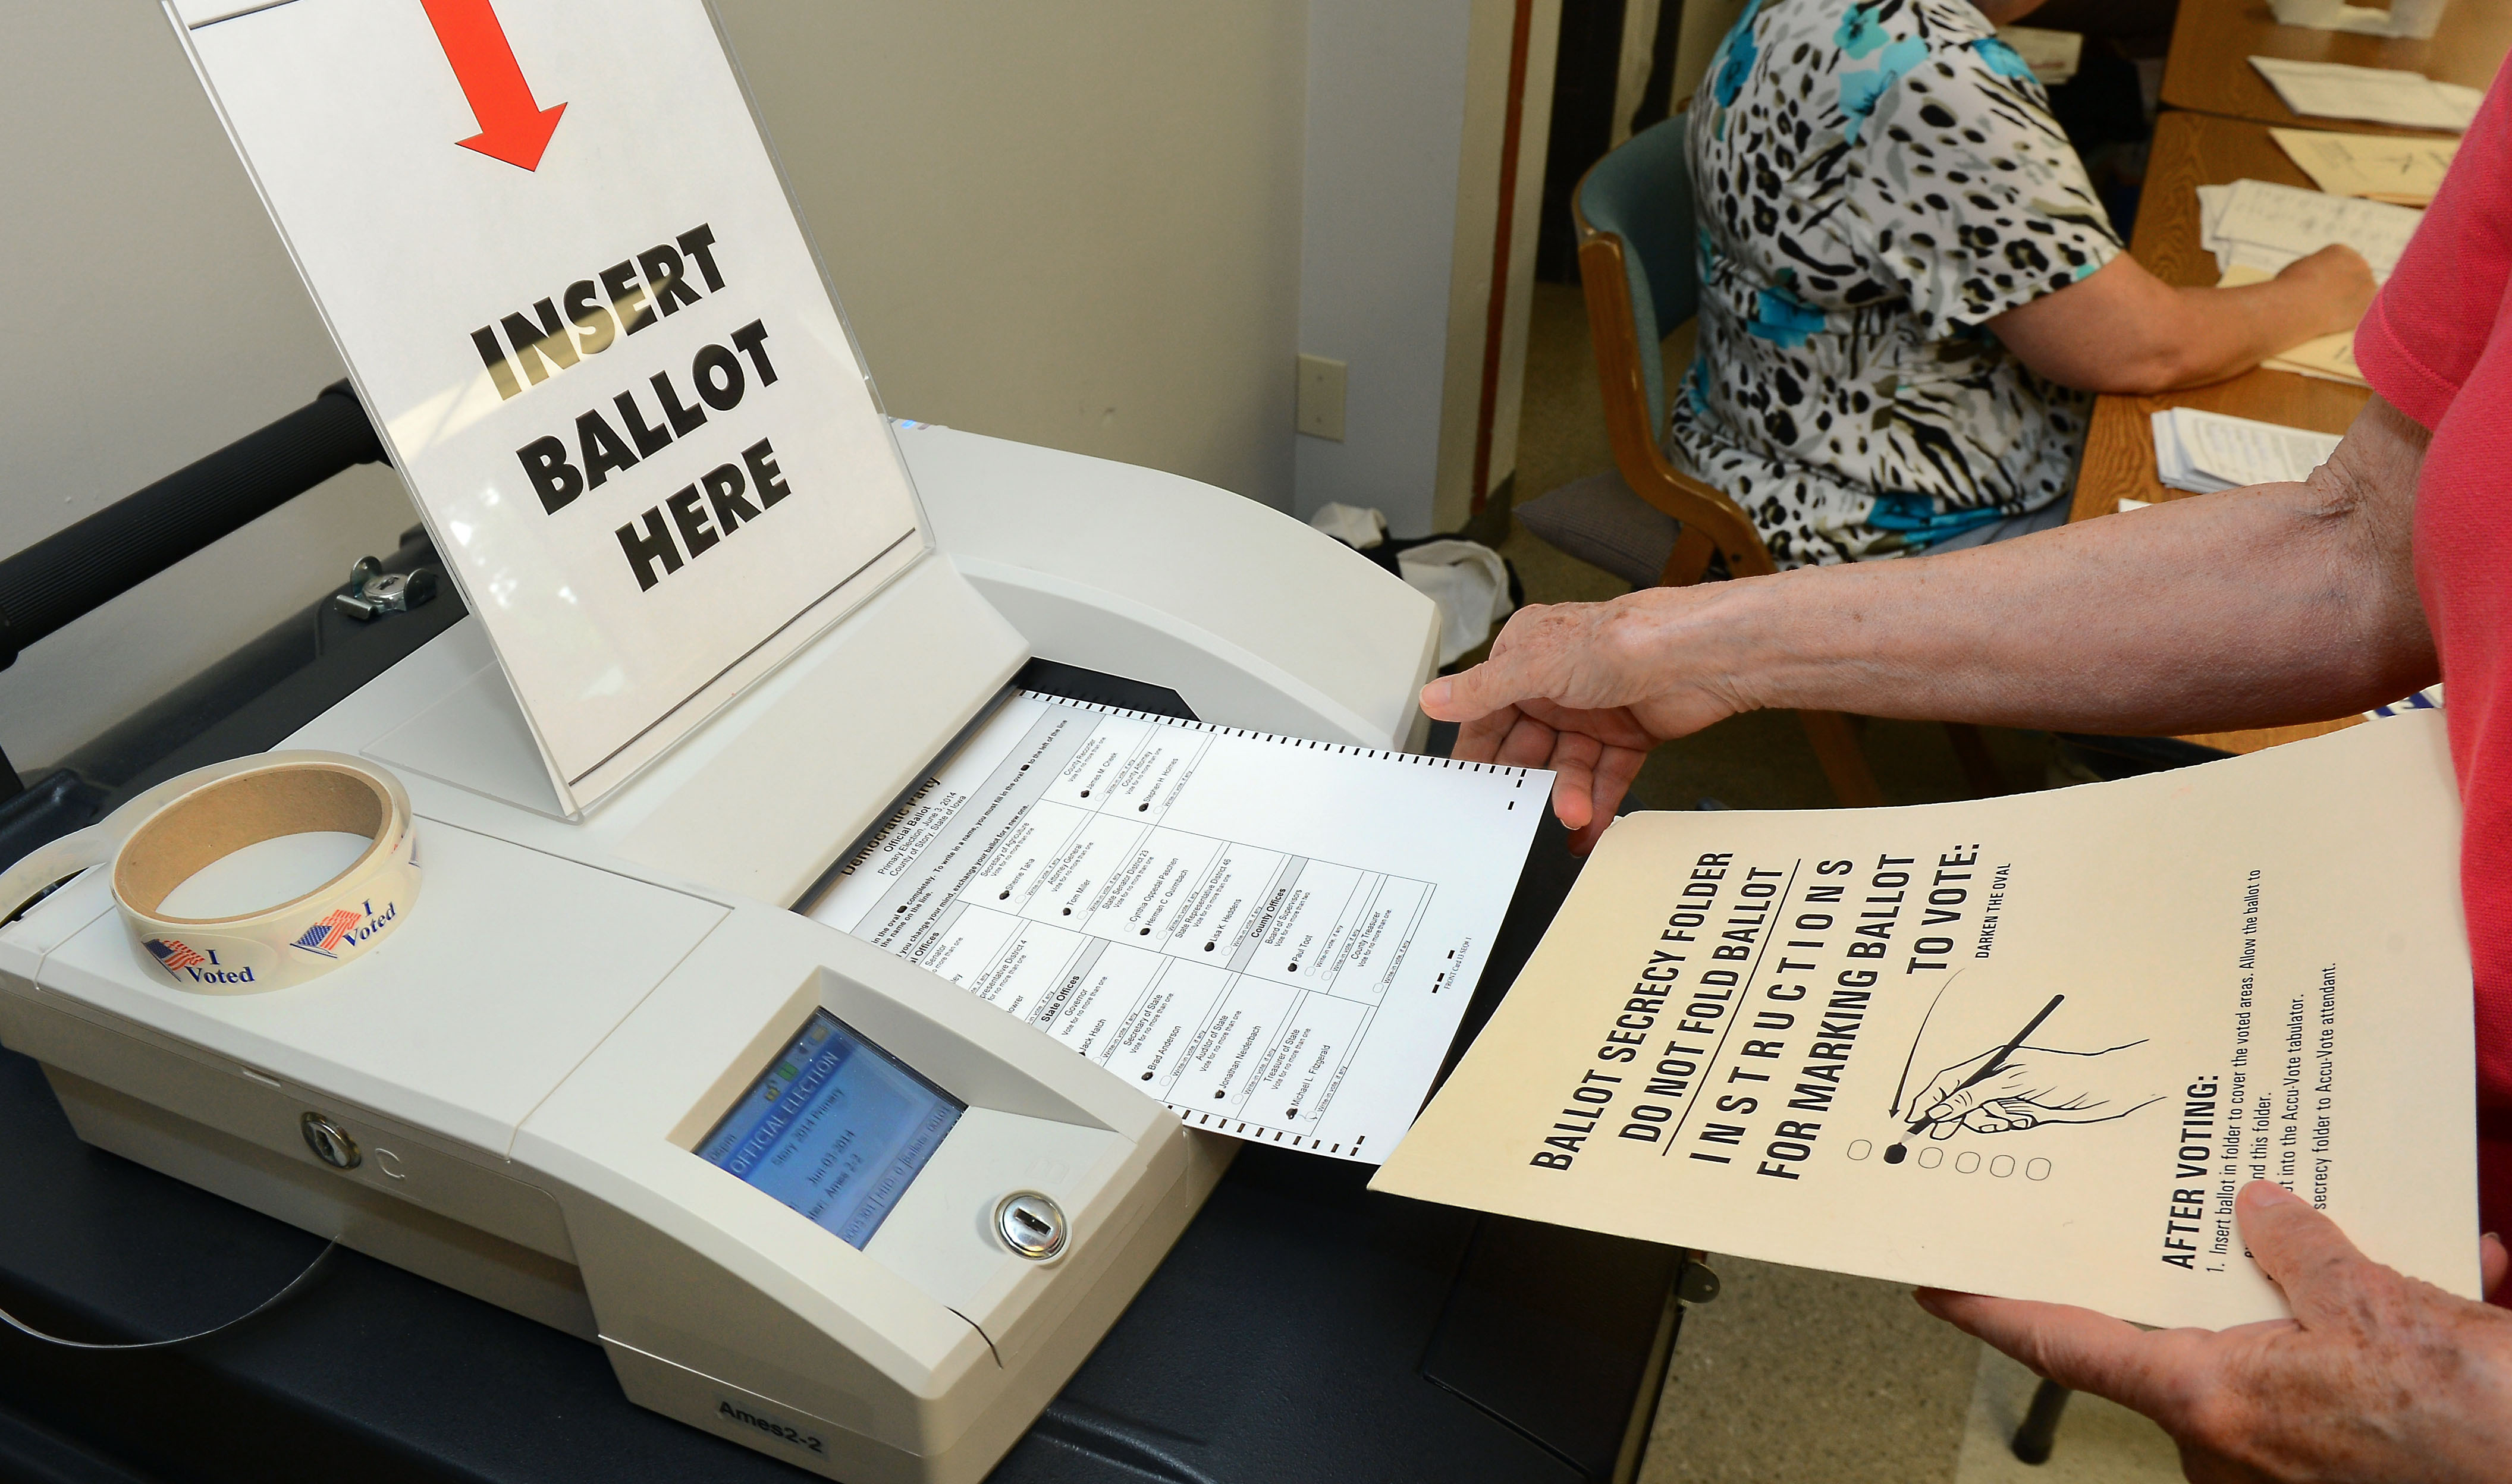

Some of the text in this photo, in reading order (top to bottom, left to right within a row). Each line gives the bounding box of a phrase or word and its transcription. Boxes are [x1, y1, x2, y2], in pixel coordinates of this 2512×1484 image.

[470, 222, 726, 401] INSERT
[516, 318, 778, 516] BALLOT
[614, 436, 792, 592] HERE
[877, 851, 904, 875] Primary
[921, 812, 938, 826] June
[939, 791, 956, 806] 2014
[883, 806, 931, 852] Official Ballot
[888, 854, 913, 876] County
[930, 815, 949, 831] State
[949, 795, 966, 809] Iowa
[979, 853, 1005, 877] Secretary
[1004, 822, 1029, 847] Agriculture
[899, 942, 912, 954] you
[909, 920, 930, 942] change
[927, 907, 941, 921] your
[938, 892, 956, 907] mind,
[952, 865, 977, 891] exchange
[974, 852, 987, 866] your
[983, 837, 1001, 853] ballot
[996, 829, 1007, 838] for
[1007, 815, 1019, 826] new
[1017, 804, 1029, 815] one.
[1004, 858, 1035, 891] Sherrie Taha
[1047, 843, 1082, 885] Attorney General
[1101, 895, 1117, 909] State
[1111, 874, 1131, 895] Senator
[1126, 857, 1144, 875] District
[1129, 857, 1179, 922] Cynthia Oppedal Paschen
[361, 898, 373, 918] I
[879, 937, 892, 947] the
[889, 921, 906, 938] name
[904, 913, 914, 921] on
[909, 903, 922, 913] the
[918, 891, 933, 903] line.
[1066, 879, 1090, 906] Tom Miller
[1144, 904, 1165, 926] Herman
[1164, 869, 1188, 897] Quirmbach
[1174, 923, 1189, 938] State
[1184, 884, 1215, 923] Representative
[1209, 866, 1227, 884] District
[1208, 929, 1222, 942] Lisa
[1221, 898, 1242, 922] Heddens
[1250, 888, 1286, 938] County Offices
[1264, 926, 1280, 944] Board
[1278, 889, 1302, 920] Supervisors
[1905, 843, 1980, 974] TO VOTE:
[1974, 863, 2011, 958] DARKEN THE OVAL
[342, 902, 396, 948] Voted
[1291, 935, 1313, 962] Paul Toot
[1350, 911, 1380, 960] County Treasurer
[184, 966, 255, 984] Voted
[206, 949, 220, 965] I
[1040, 975, 1079, 1022] State Offices
[1064, 988, 1088, 1016] Governor
[1123, 1017, 1149, 1046] Secretary
[1147, 994, 1163, 1010] State
[1528, 853, 1734, 1171] BALLOT SECRECY FOLDER
[1618, 866, 1783, 1142] DO NOT FOLD BALLOT
[1756, 853, 1915, 1180] FOR MARKING BALLOT
[2285, 993, 2304, 1052] tabulator.
[1078, 1018, 1106, 1052] Jack Hatch
[1147, 1025, 1181, 1070] Brad Anderson
[1195, 1015, 1229, 1061] Auditor of State
[1218, 1025, 1261, 1089] Jonathan Neiderbach
[1263, 1029, 1300, 1081] Treasurer of State
[1290, 1081, 1310, 1106] Michael
[1308, 1044, 1330, 1074] Fitzgerald
[2206, 869, 2260, 1274] 1. Insert ballot in folder to cover the voted areas. Allow the ballot to
[2280, 1057, 2301, 1120] Accu-Vote
[2311, 963, 2335, 1209] secrecy folder to Accu-Vote attendant.
[730, 1051, 840, 1174] OFFICIAL ELECTION
[2248, 1092, 2271, 1179] nd this folder.
[2279, 1125, 2297, 1146] the
[2161, 1075, 2218, 1271] AFTER VOTING:
[2276, 1150, 2296, 1175] into
[720, 1400, 824, 1454] Ames2-2
